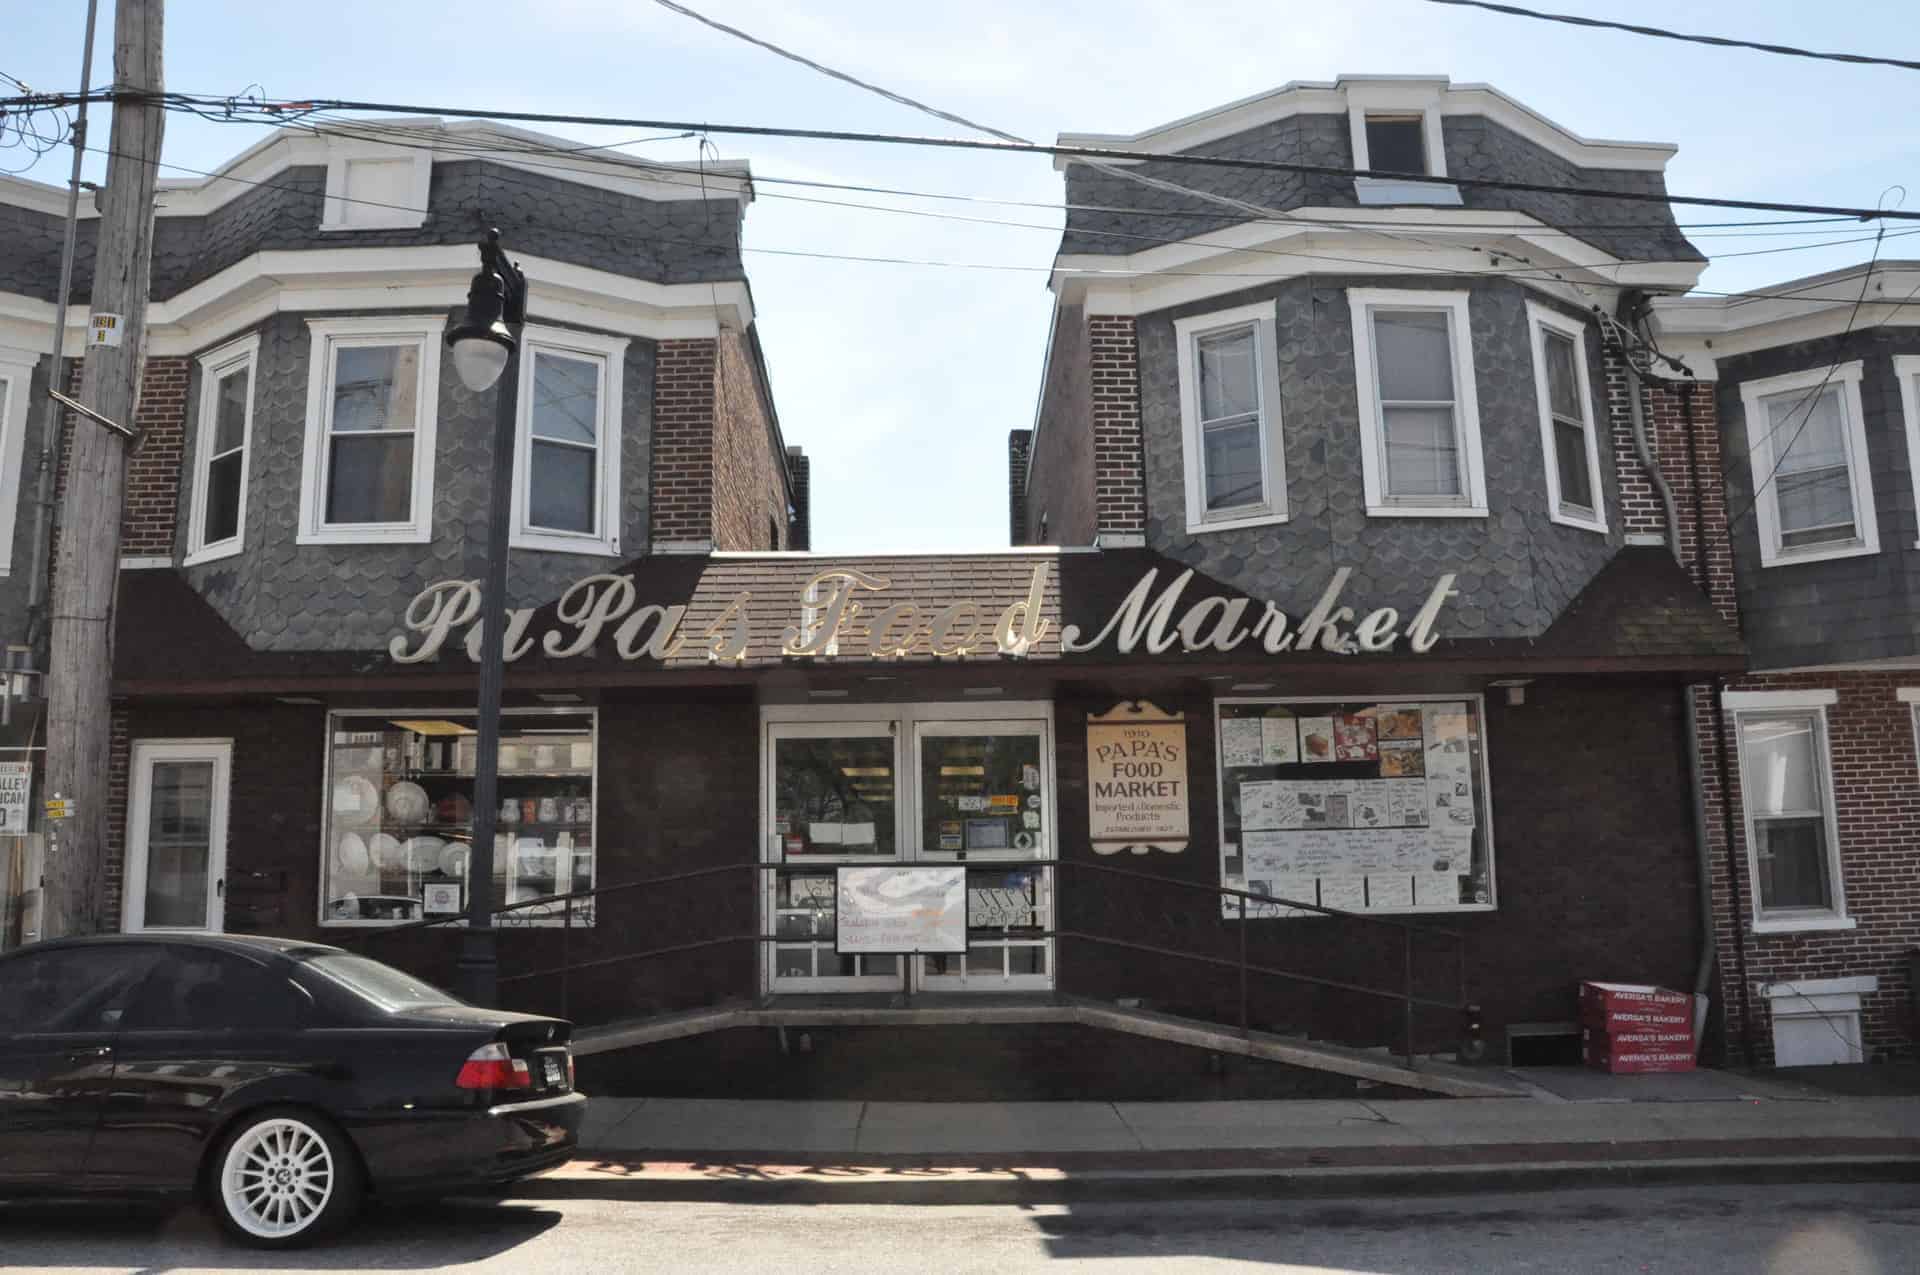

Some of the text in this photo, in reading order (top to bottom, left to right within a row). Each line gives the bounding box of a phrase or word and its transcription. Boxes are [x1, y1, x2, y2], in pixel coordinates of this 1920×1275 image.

[782, 561, 1051, 657] Food
[1063, 567, 1459, 654] Market
[1096, 740, 1179, 763] PAPA'S
[1112, 762, 1163, 778] FOOD
[0, 777, 28, 790] LLEY
[1095, 781, 1180, 798] MARKET
[0, 791, 26, 804] ICAN
[1095, 802, 1135, 814] Imported
[1116, 811, 1161, 821] Products
[1614, 992, 1687, 1003] AVERSA'S BAKERY
[1612, 1013, 1685, 1024] AVERSA'S BAKERY
[1617, 1034, 1656, 1042] AVERSA'S
